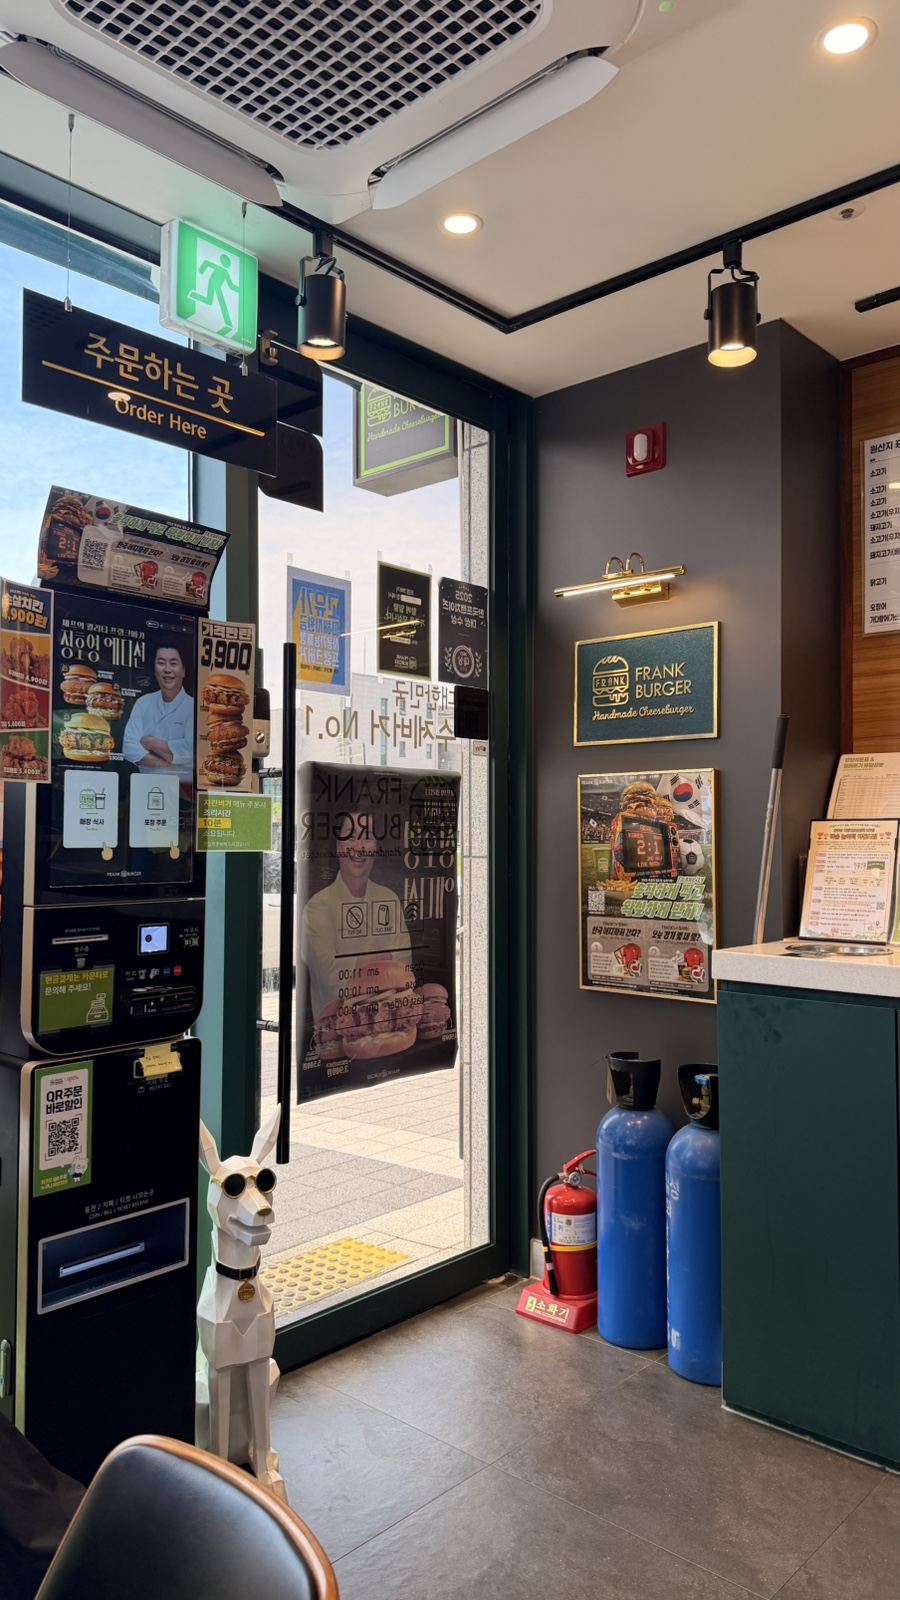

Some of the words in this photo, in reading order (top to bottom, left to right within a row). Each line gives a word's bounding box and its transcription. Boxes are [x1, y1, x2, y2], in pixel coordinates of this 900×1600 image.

[84, 332, 199, 400] 주문하는
[207, 375, 234, 413] 곳
[115, 397, 164, 426] Order
[170, 413, 207, 439] Here
[367, 424, 401, 441] Handmade
[870, 441, 893, 454] 원산지
[870, 467, 887, 478] 소고기
[870, 485, 887, 495] 소고기
[870, 497, 887, 507] 소고기
[870, 521, 892, 532] 돼지고기
[58, 538, 77, 551] 2:1
[870, 577, 887, 587] 닭고기
[8, 593, 45, 613] 살치킨
[870, 602, 887, 612] 오징어
[5, 608, 48, 630] ,900원
[103, 636, 145, 669] 에디션
[200, 638, 253, 671] 3,900
[635, 662, 686, 682] FRANK
[595, 676, 626, 688] FRANK
[635, 679, 692, 699] BURGER
[592, 706, 639, 721] Handmade
[638, 704, 695, 717] Cheeseburger
[203, 799, 232, 808] 치킨버거
[247, 801, 267, 809] 주문시
[203, 809, 233, 818] 조리시간
[79, 818, 92, 826] 매장
[93, 818, 105, 826] 식사
[156, 819, 167, 827] 주문
[203, 819, 221, 827] 10분
[202, 829, 237, 838] 소요됩니다.
[637, 840, 660, 855] 2:1
[632, 882, 682, 900] 솔직하게
[680, 884, 706, 901] 찍고
[669, 901, 706, 921] 받자!
[592, 926, 603, 935] 한국
[625, 929, 641, 938] 간다?
[652, 930, 663, 939] 오늘
[663, 930, 676, 940] 경기
[45, 973, 80, 985] 현금결제는
[82, 970, 110, 981] 카운터로
[45, 986, 67, 996] 문의해
[68, 983, 92, 993] 주세요!
[46, 1085, 83, 1103] QR주문
[46, 1097, 83, 1115] 바로할인
[84, 1204, 97, 1215] 동전
[102, 1199, 114, 1209] 지폐
[120, 1195, 131, 1204] 티켓
[132, 1188, 155, 1200] 나오는곳
[104, 1208, 113, 1216] BILL
[117, 1203, 131, 1212] TICKET
[535, 1300, 570, 1320] 소화기
